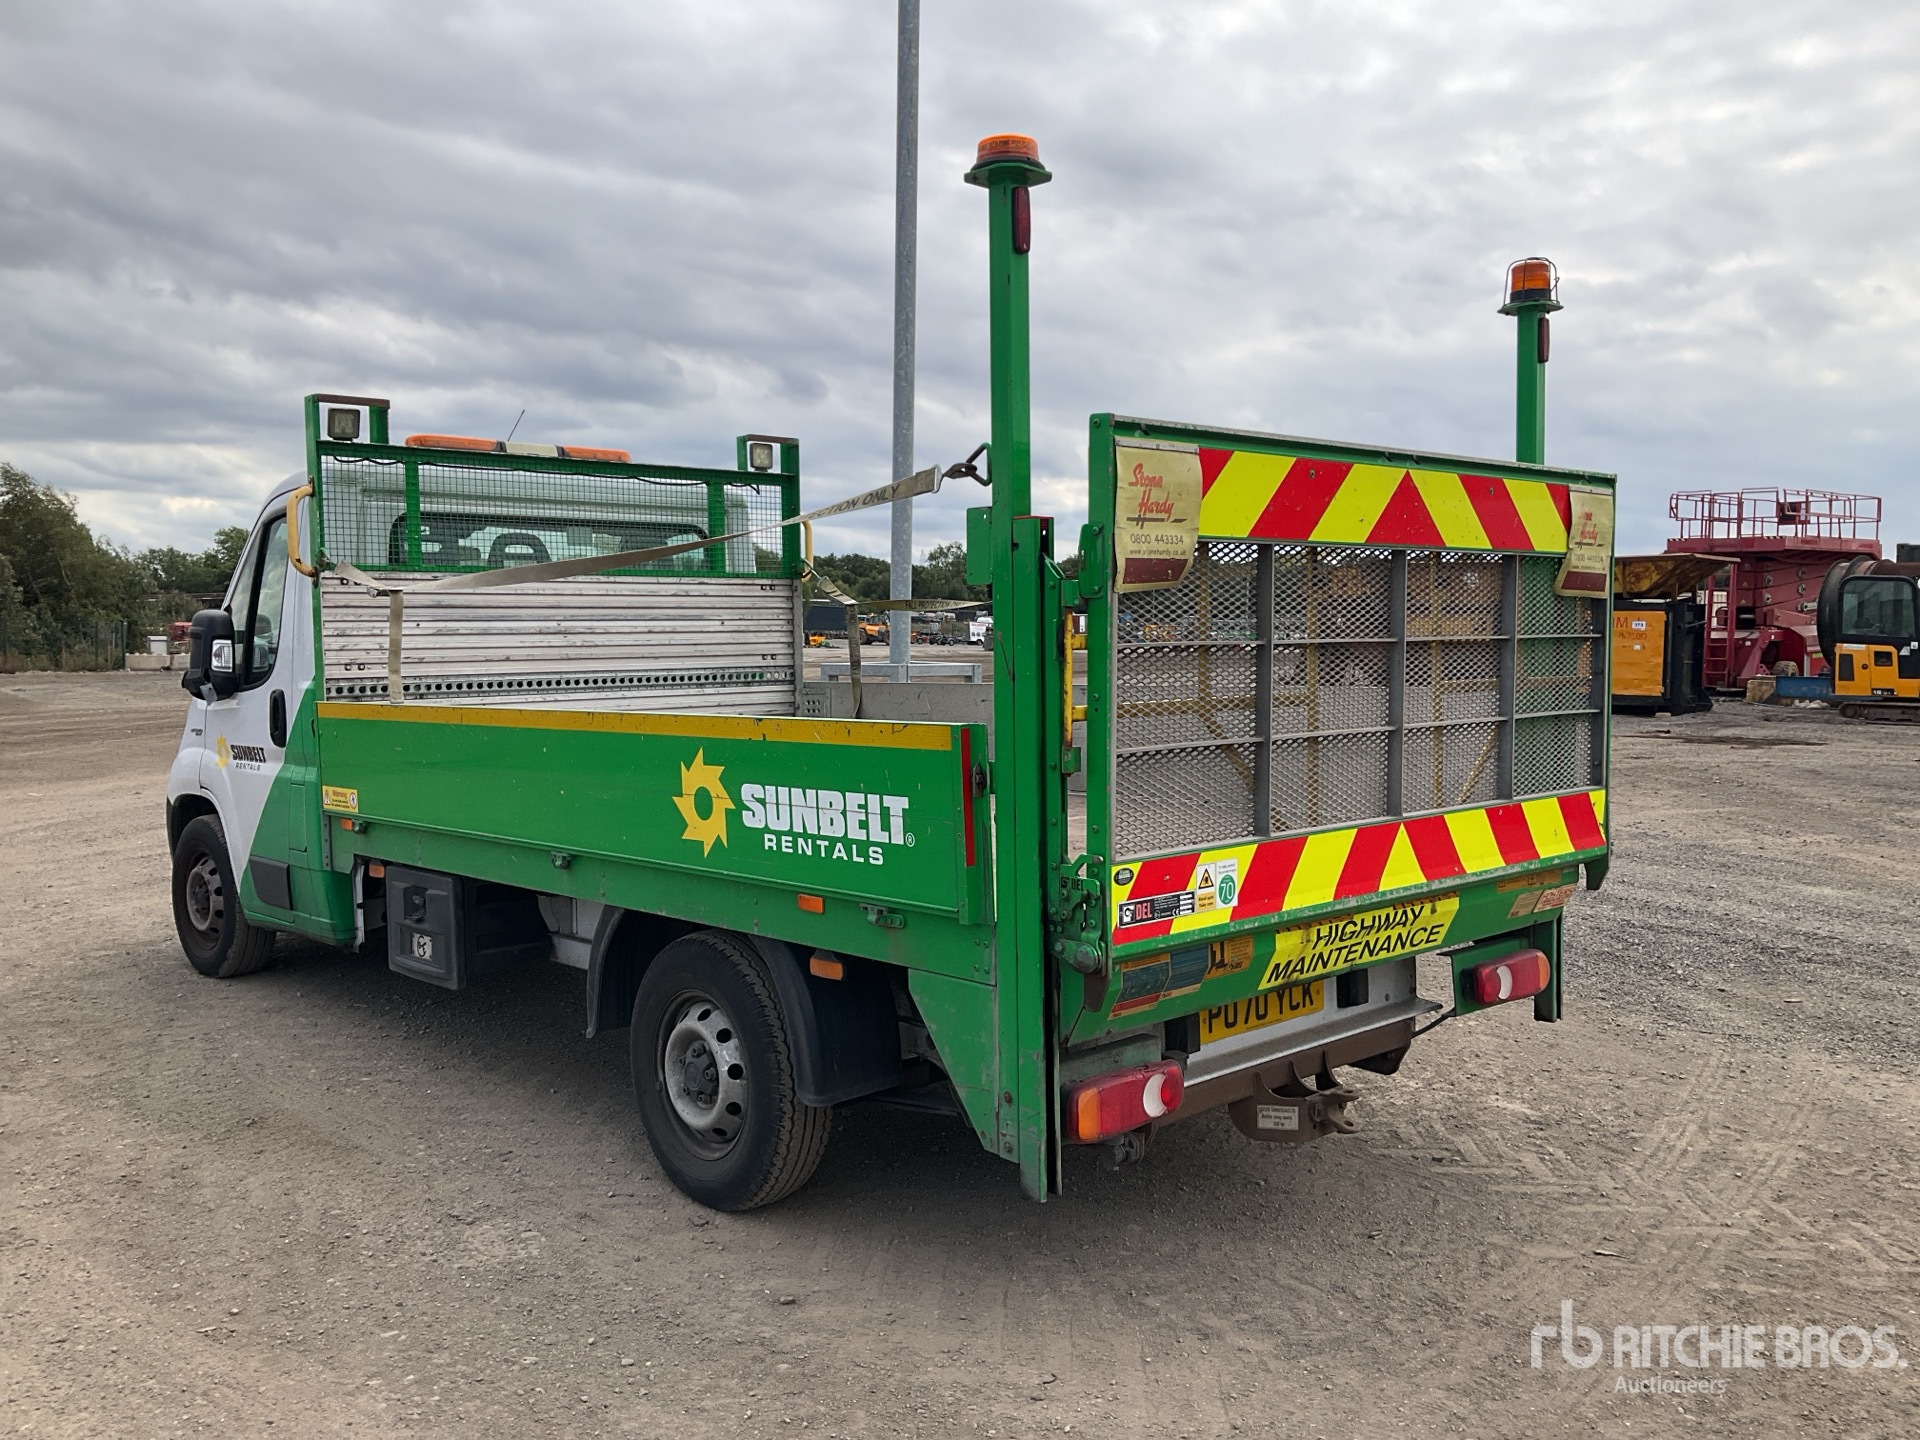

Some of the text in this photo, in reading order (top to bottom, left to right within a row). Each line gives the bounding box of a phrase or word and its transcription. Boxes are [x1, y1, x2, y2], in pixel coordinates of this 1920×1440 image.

[862, 484, 900, 505] ONLY
[1138, 489, 1174, 522] Hardy
[1130, 533, 1184, 546] 0800 443334
[230, 744, 267, 763] SUNBELT
[235, 762, 261, 772] RENTALS
[741, 783, 909, 845] SUNBELT
[763, 833, 884, 865] RENTALS
[1220, 882, 1234, 900] 70
[1135, 902, 1153, 920] DEL
[1312, 905, 1425, 950] HIGHWAY
[1267, 923, 1444, 983] MAINTENANCE
